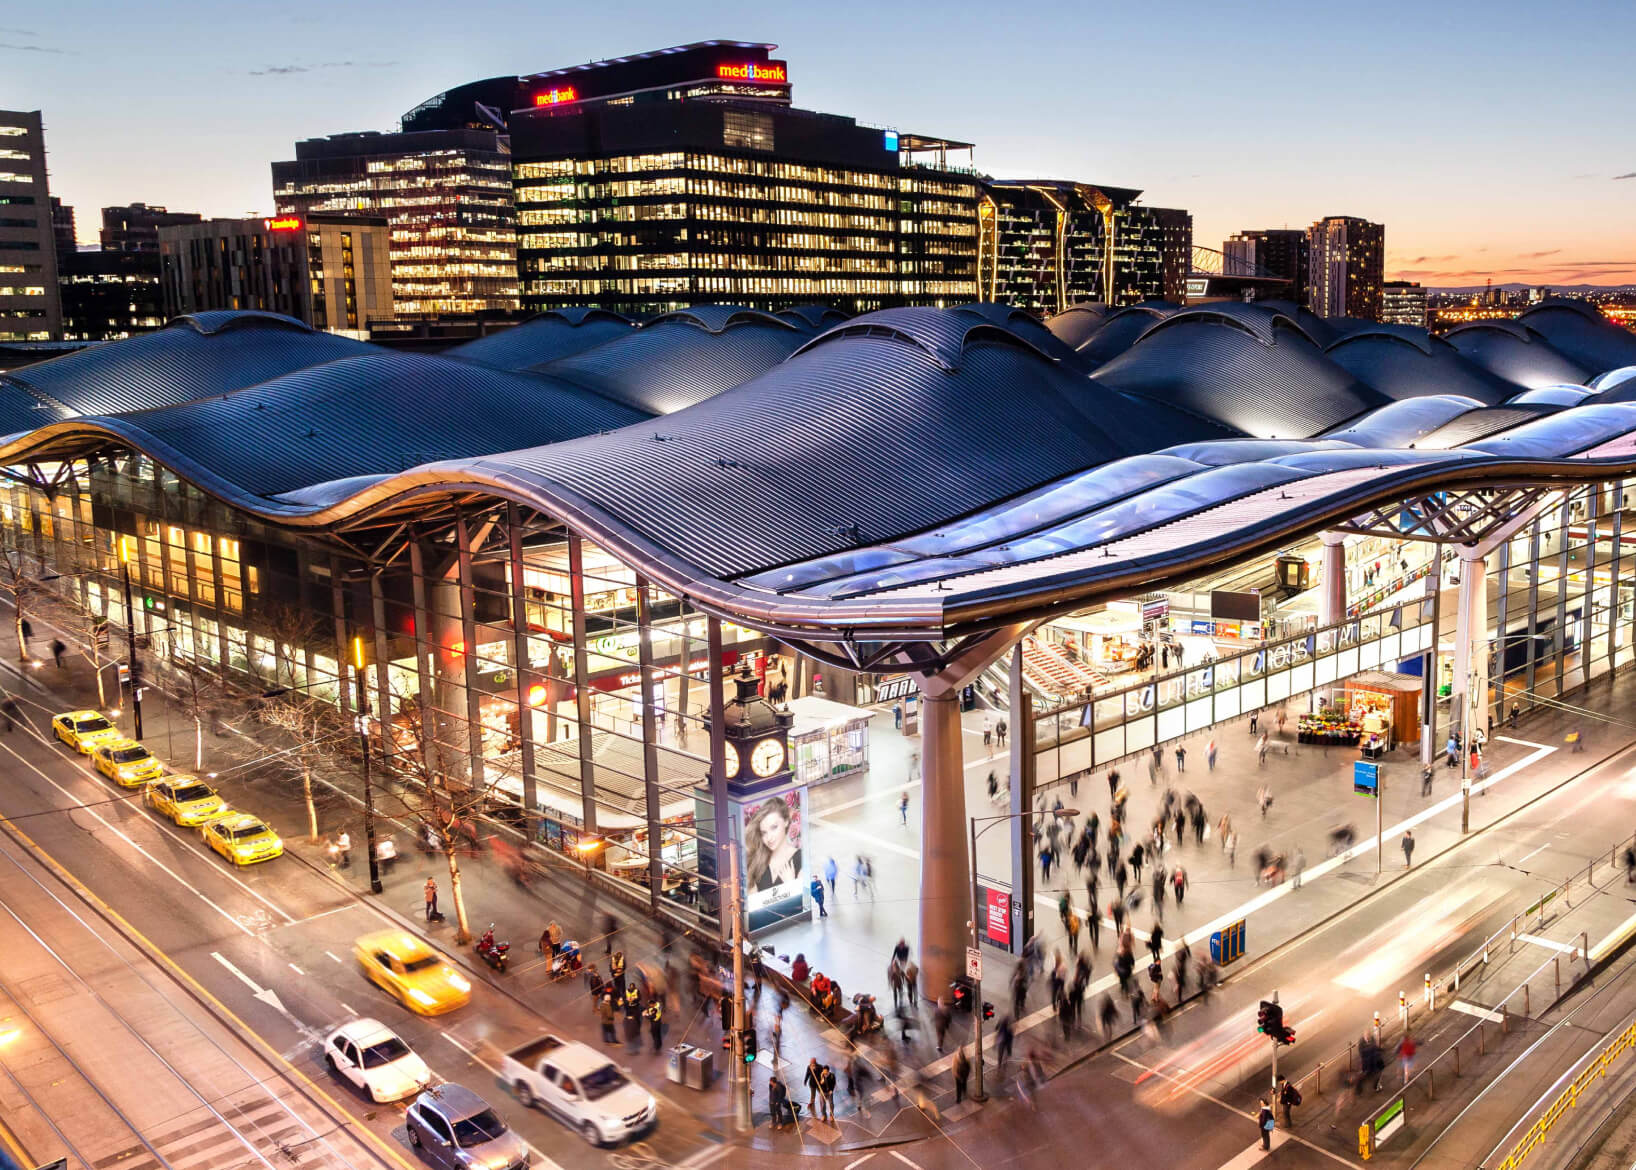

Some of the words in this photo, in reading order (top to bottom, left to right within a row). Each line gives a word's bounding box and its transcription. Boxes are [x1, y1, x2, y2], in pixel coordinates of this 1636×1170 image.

[719, 64, 785, 80] medibank
[536, 87, 576, 105] medibank
[1249, 639, 1308, 676] CROSS
